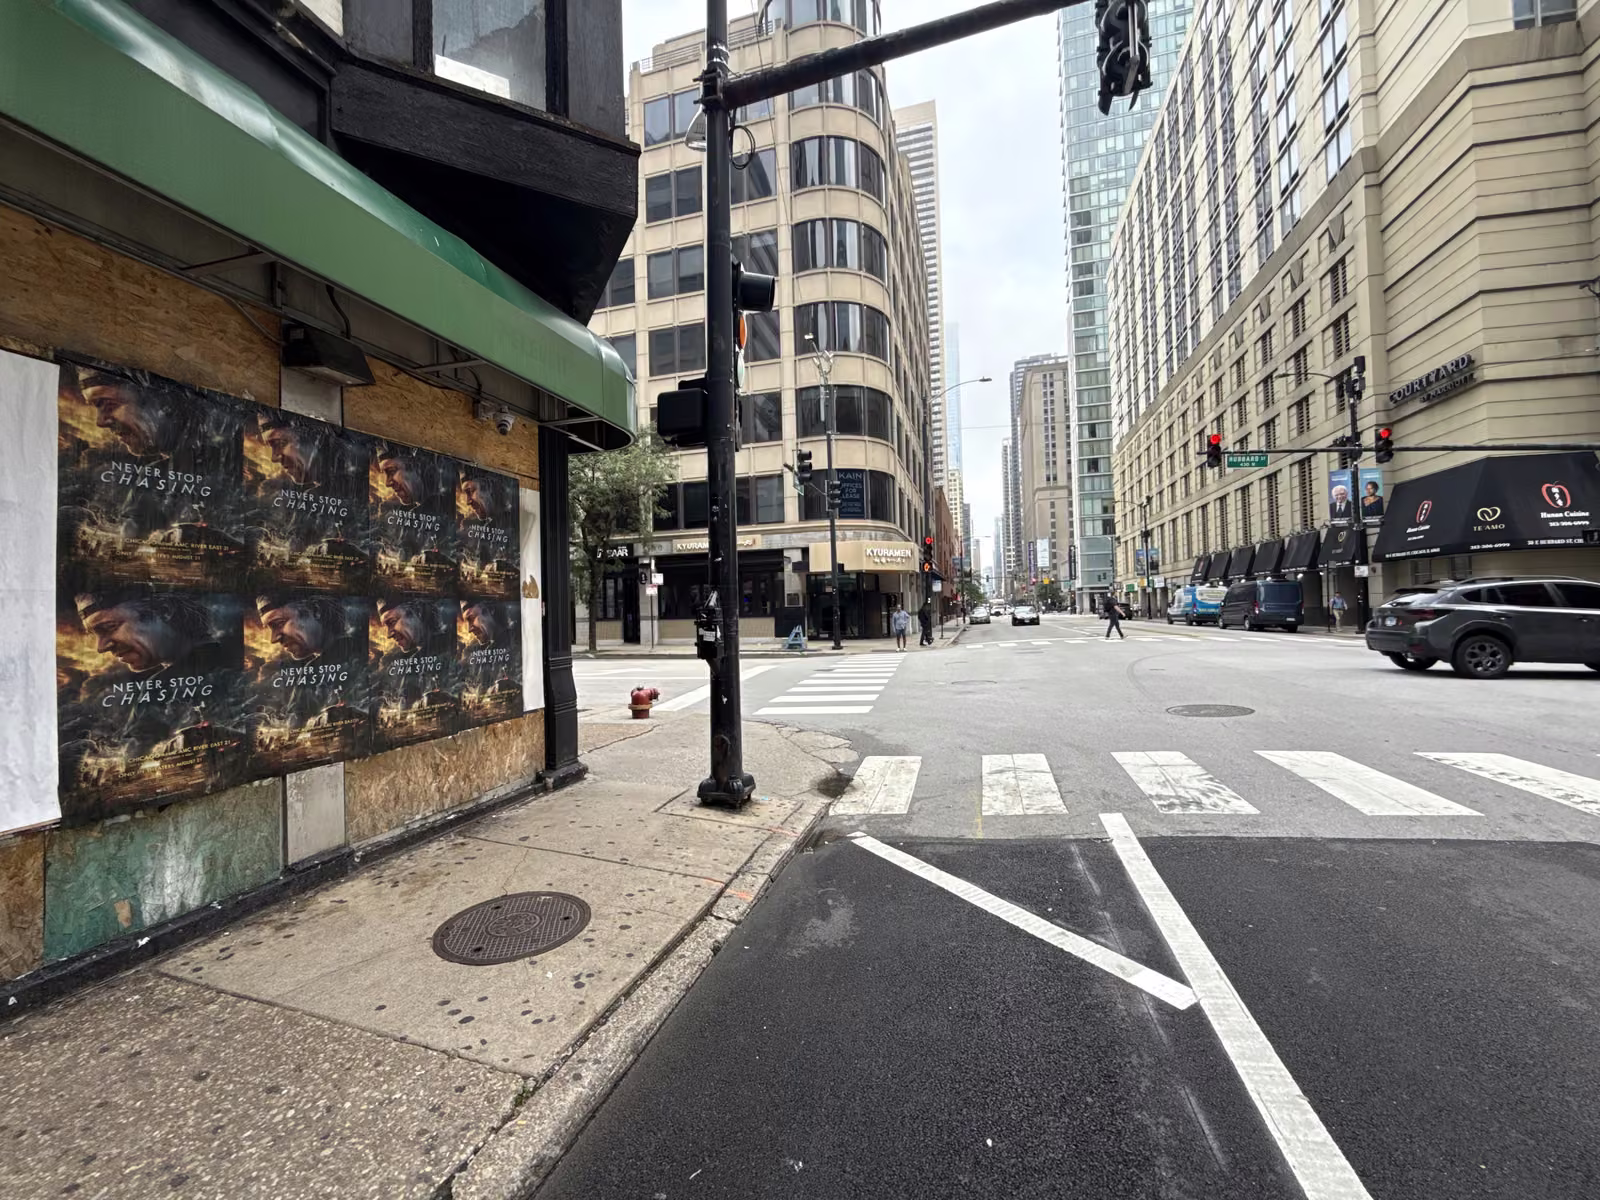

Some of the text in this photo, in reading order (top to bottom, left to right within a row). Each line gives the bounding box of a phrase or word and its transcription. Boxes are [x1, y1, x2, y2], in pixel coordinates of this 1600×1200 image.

[1390, 354, 1473, 403] COURTYARD
[112, 461, 203, 483] NEVER STOP
[101, 471, 212, 497] CHASING
[281, 489, 342, 506] NEVER STOP
[273, 497, 348, 517] CHASING
[392, 509, 437, 522] NEVER STOP
[1564, 510, 1590, 518] Cuisine
[387, 516, 440, 532] CHASING
[471, 524, 505, 535] NEVER STOP
[467, 530, 508, 543] CHASING
[676, 542, 709, 550] KYURAM
[866, 547, 912, 557] KYURAMEN
[472, 649, 491, 657] NEVER
[393, 658, 418, 667] NEVER
[469, 655, 510, 665] CHASING
[280, 664, 342, 677] NEVER STOP
[388, 662, 442, 676] CHASING
[113, 675, 204, 694] NEVER STOP
[272, 671, 348, 688] CHASING
[102, 684, 213, 708] CHASING
